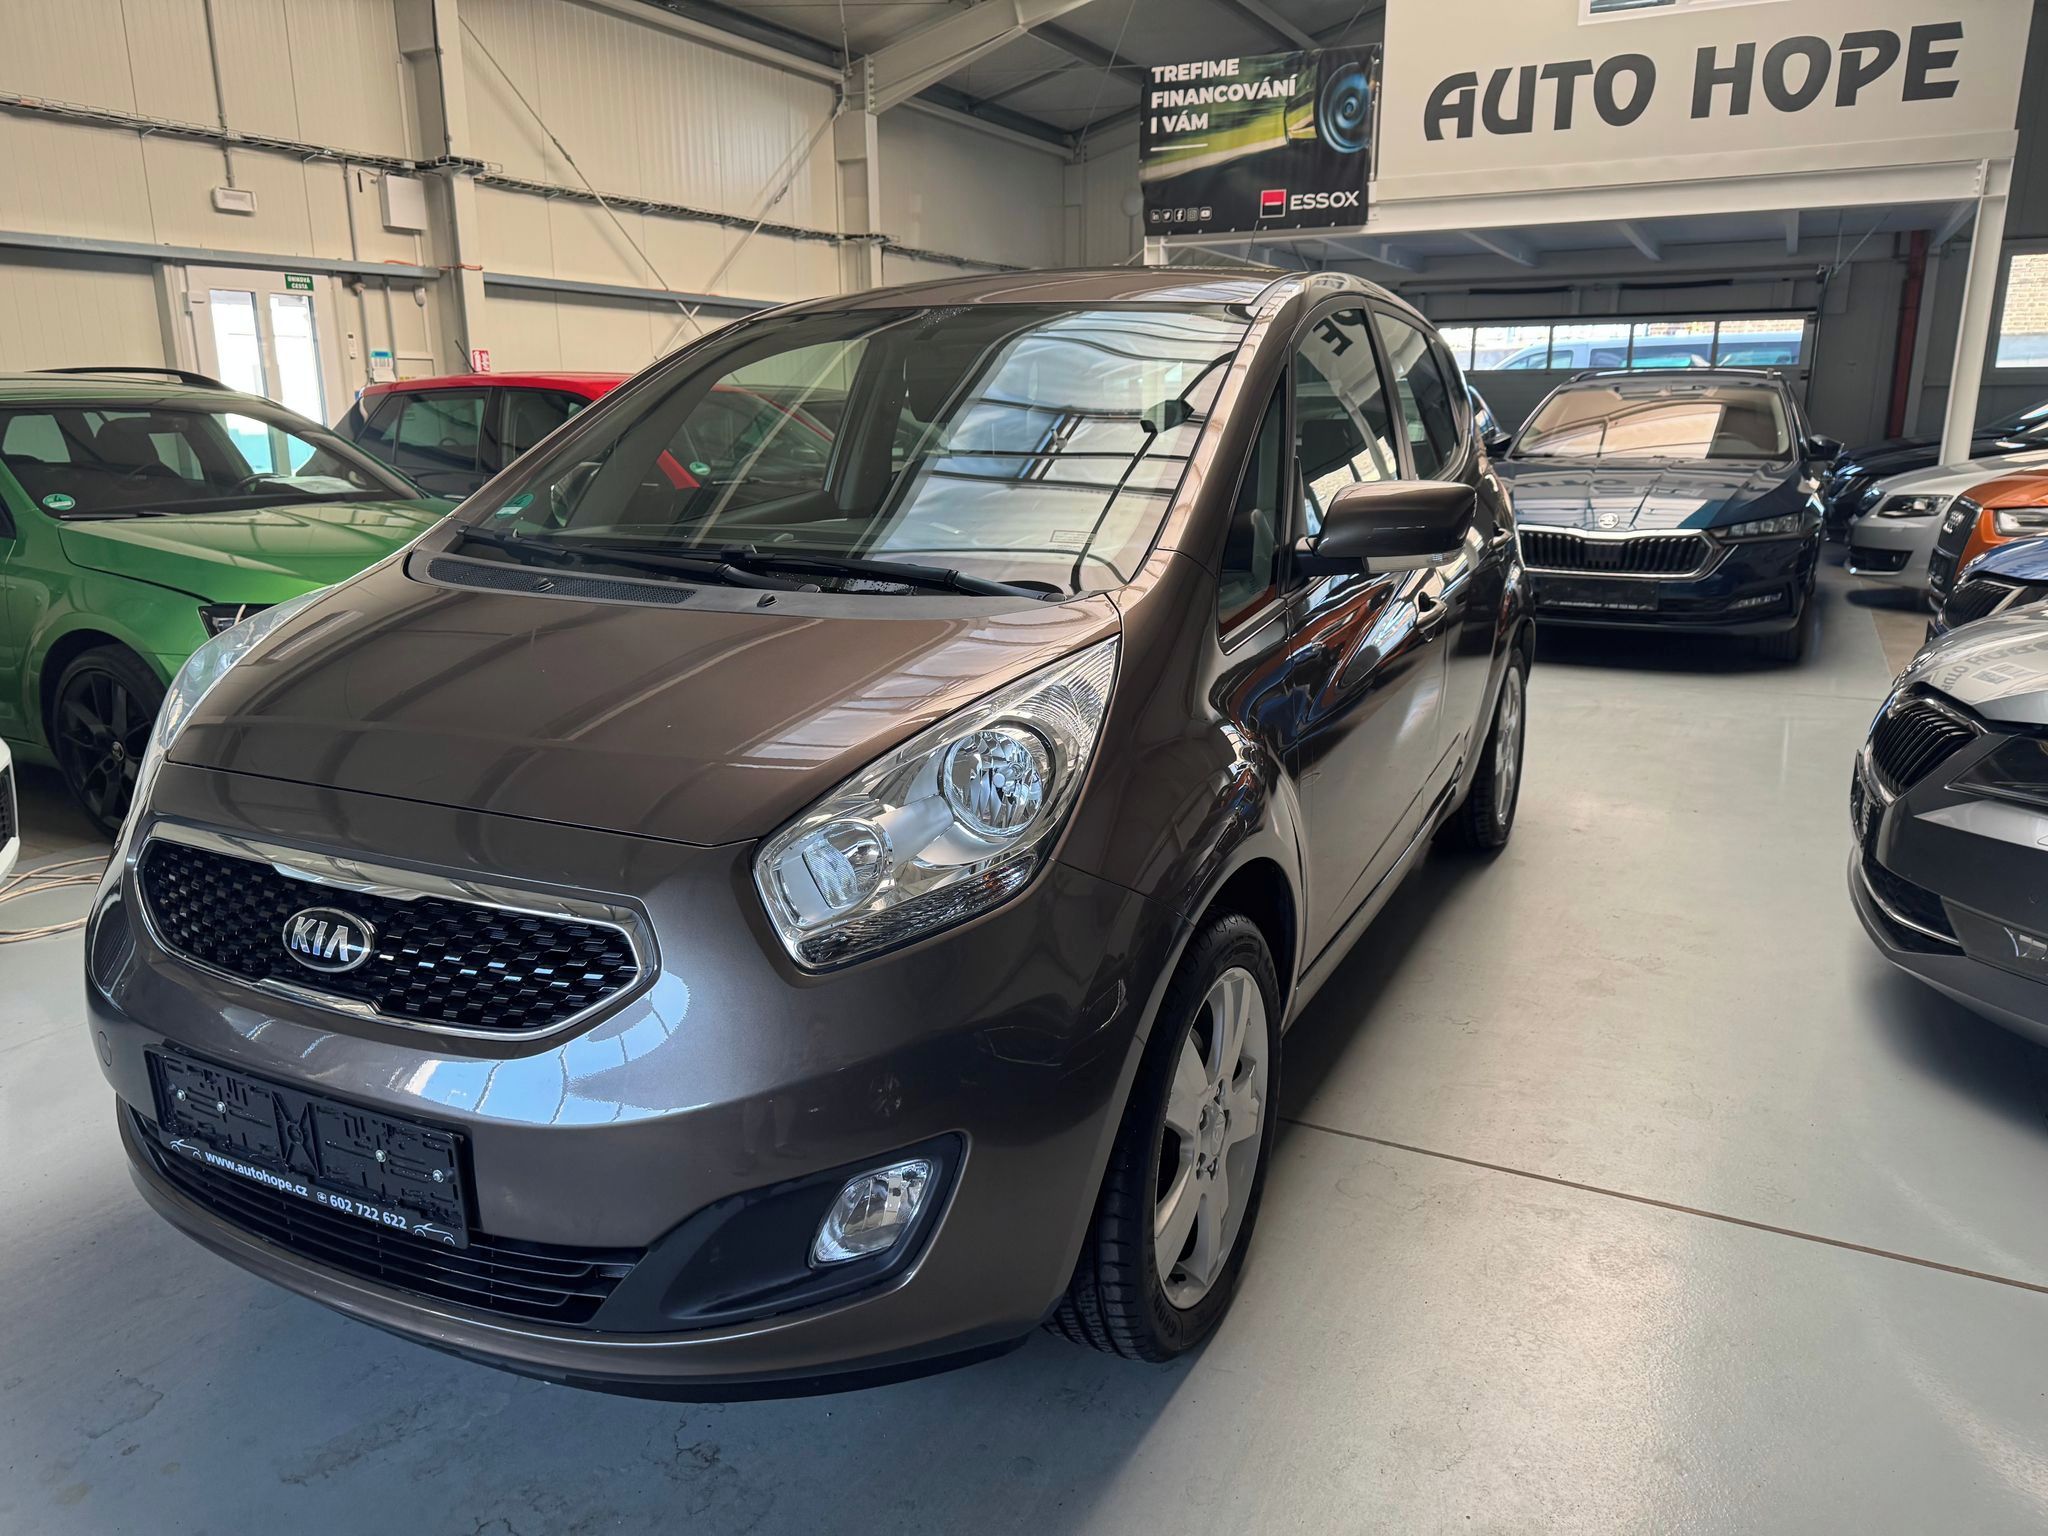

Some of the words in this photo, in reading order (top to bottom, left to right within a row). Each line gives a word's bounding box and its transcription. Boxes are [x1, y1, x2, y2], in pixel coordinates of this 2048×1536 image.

[1151, 58, 1240, 84] TREFIME
[1423, 53, 1657, 141] AUTO
[1690, 21, 1964, 120] HOPE
[1151, 74, 1297, 109] FINANCOVÁNÍ
[1150, 116, 1158, 134] I
[1162, 110, 1209, 134] VÁM
[1290, 190, 1360, 211] ESSOX
[291, 916, 349, 962] KIA
[204, 1151, 308, 1197] www.autohope.cz
[330, 1194, 353, 1213] 602
[355, 1202, 380, 1221] 722
[382, 1211, 408, 1230] 622
